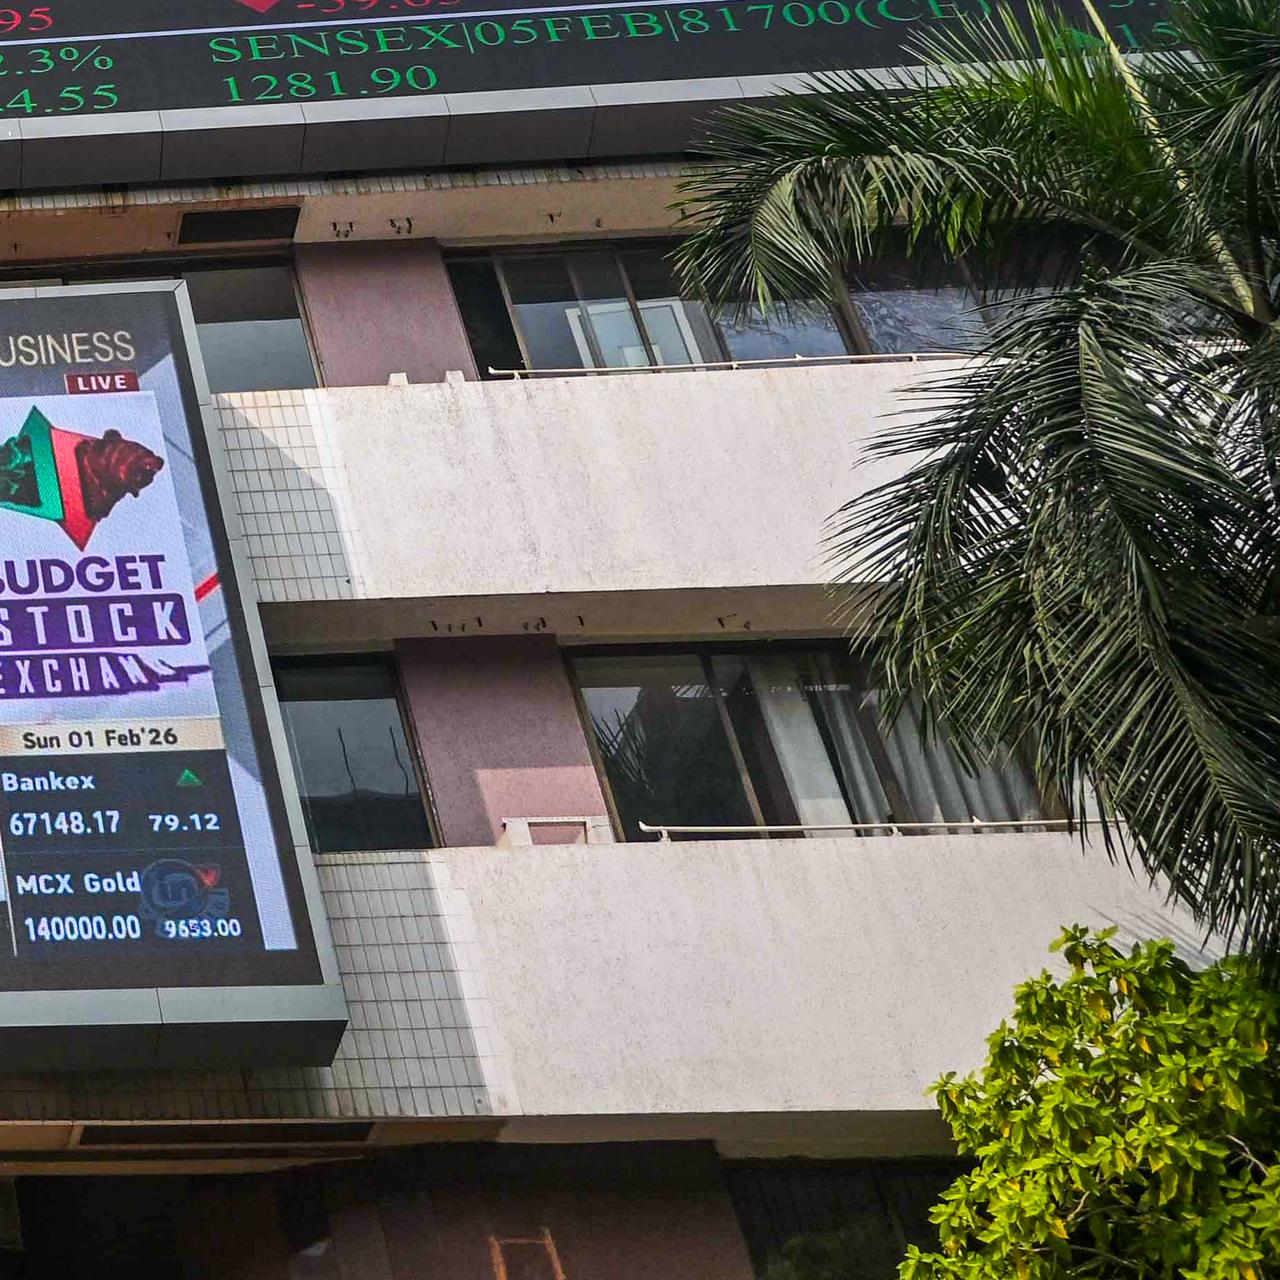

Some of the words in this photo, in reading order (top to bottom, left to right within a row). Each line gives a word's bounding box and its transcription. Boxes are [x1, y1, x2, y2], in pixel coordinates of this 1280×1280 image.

[223, 64, 438, 103] 1281.90
[6, 84, 118, 114] 4.55
[77, 374, 128, 391] LIVE
[23, 732, 60, 749] Sun
[69, 731, 94, 747] 01
[105, 728, 178, 746] Feb'26
[2, 771, 95, 792] Bankex
[10, 810, 120, 836] 67148.17
[149, 814, 220, 832] 79.12
[16, 874, 73, 895] MCX
[84, 871, 140, 893] Gold
[25, 915, 140, 941] 140000.00
[165, 919, 241, 938] 9653.00
